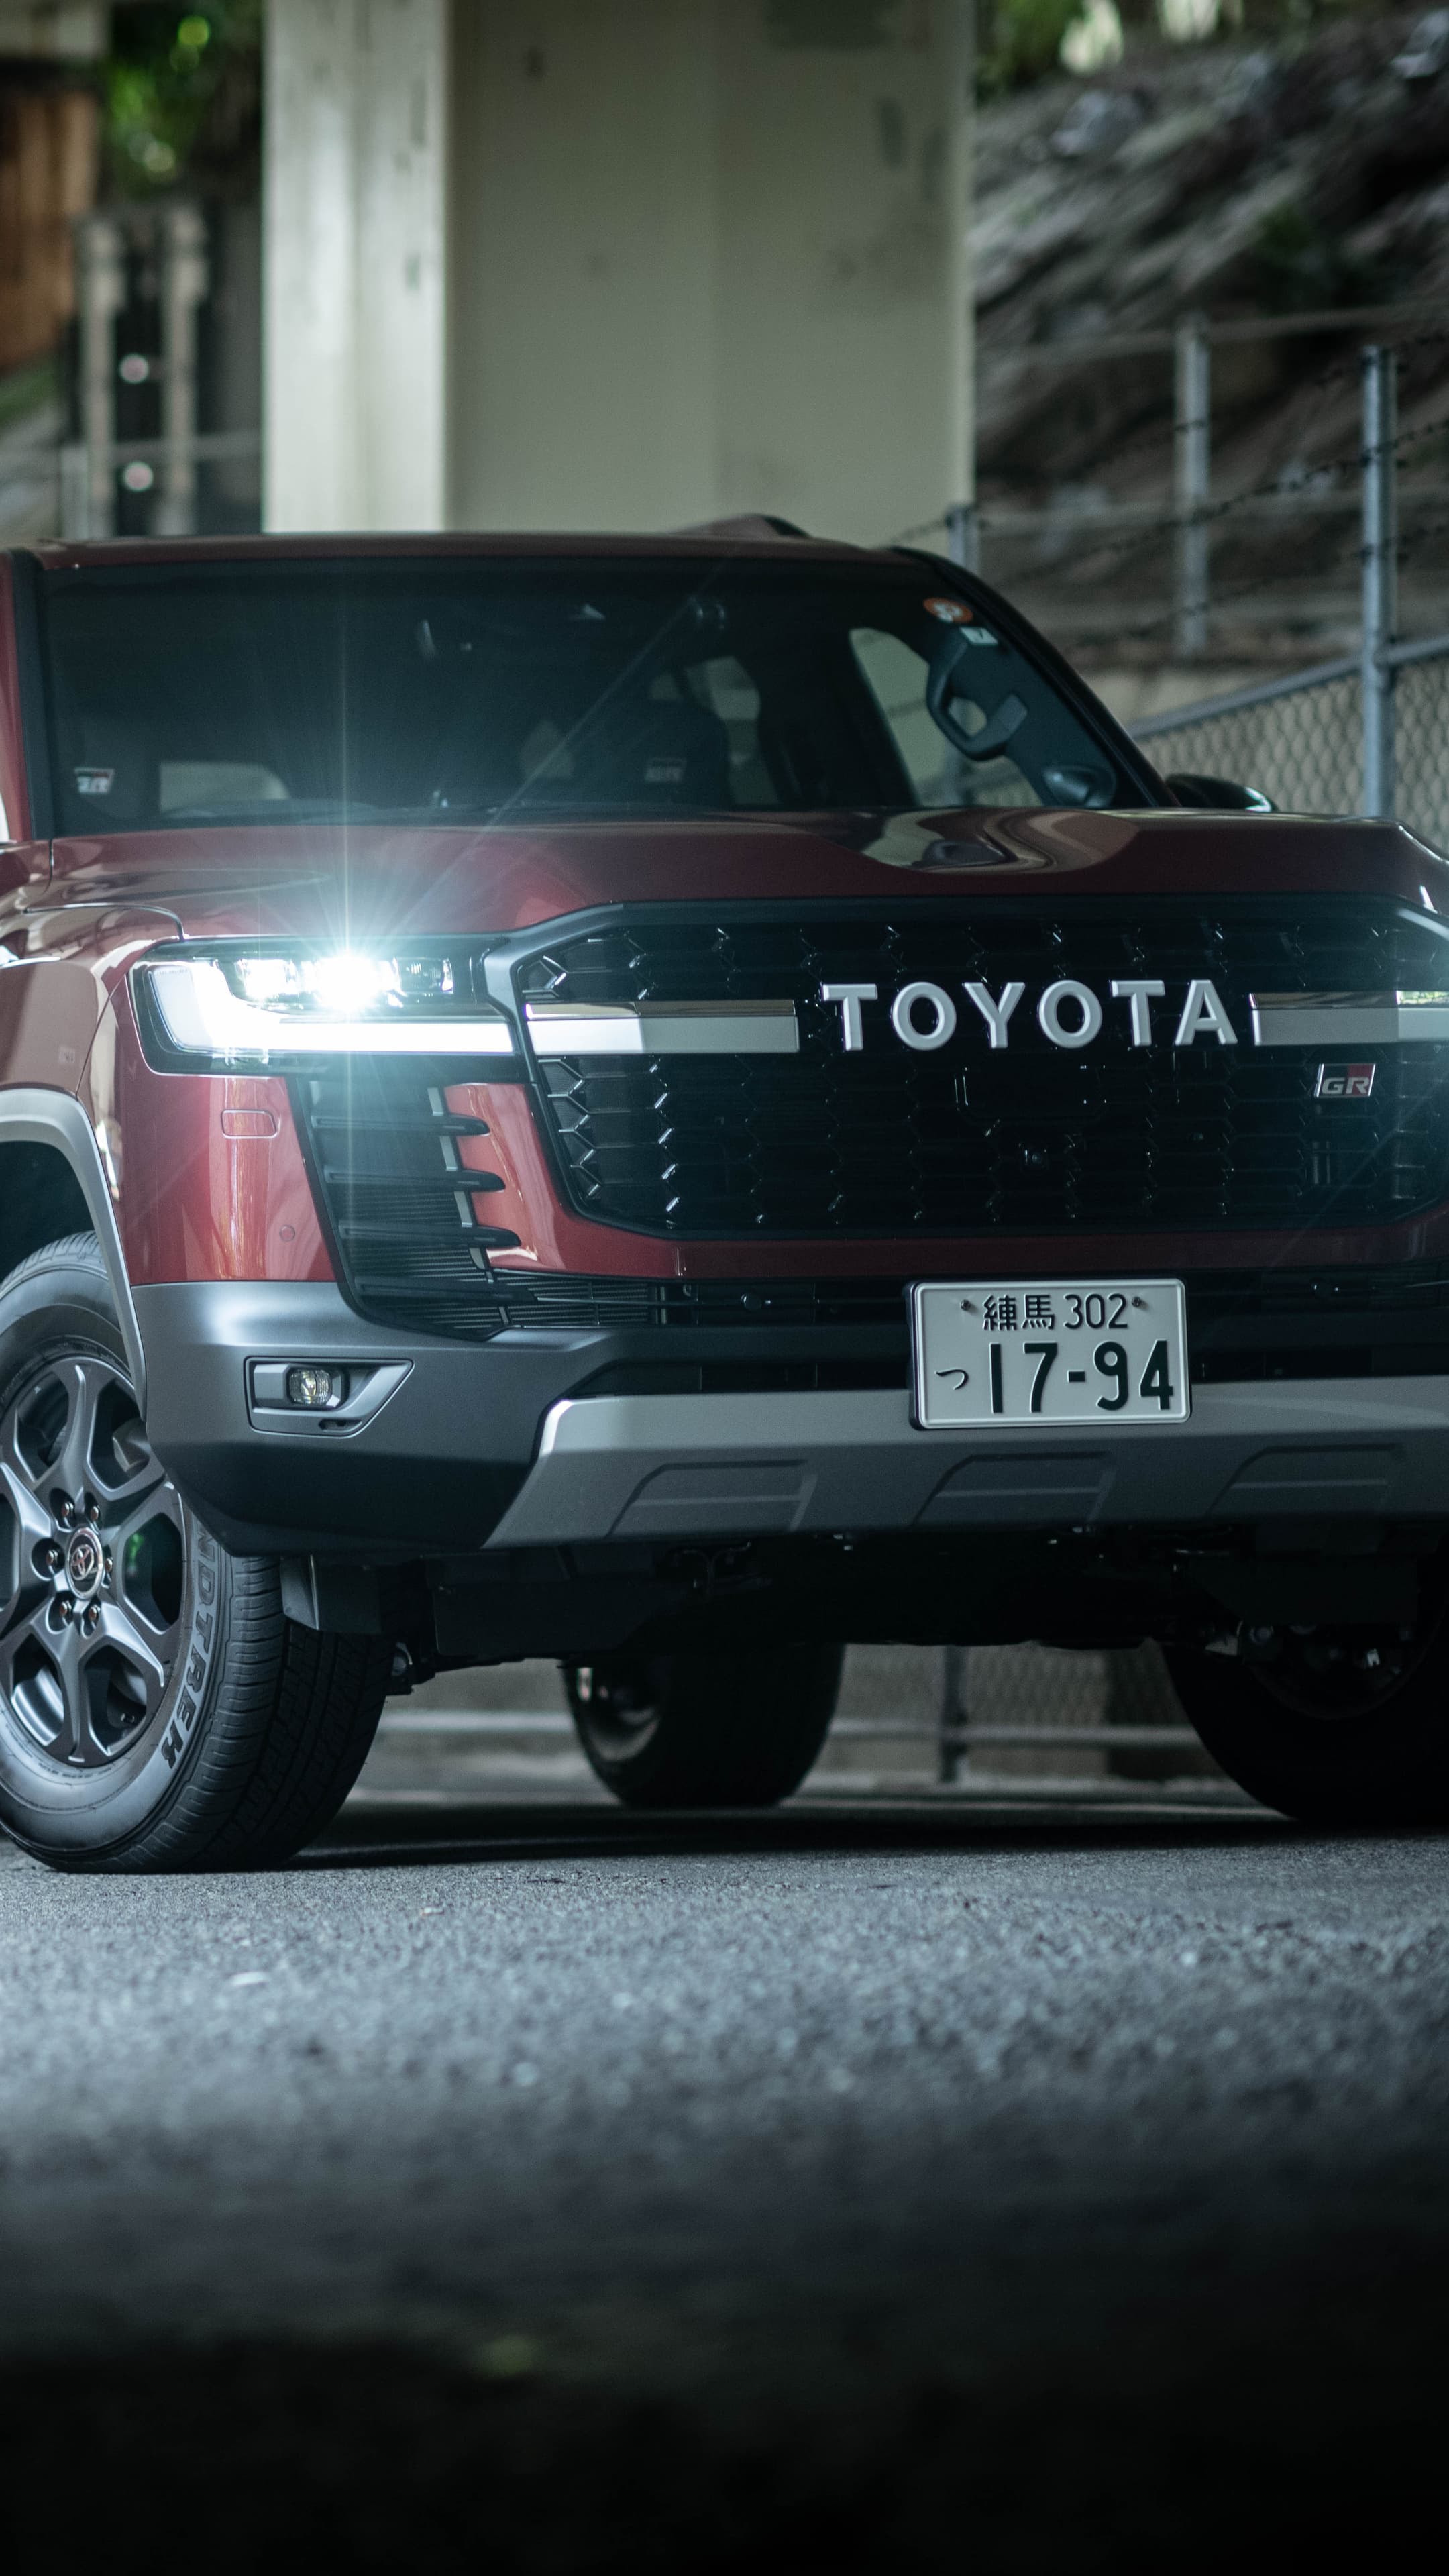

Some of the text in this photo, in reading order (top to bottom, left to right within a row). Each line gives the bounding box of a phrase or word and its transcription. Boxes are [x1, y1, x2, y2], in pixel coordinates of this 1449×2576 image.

[821, 979, 1238, 1051] TOYOTA
[1321, 1077, 1370, 1094] GR
[982, 1293, 1129, 1331] 練馬 302
[935, 1339, 1174, 1414] つ 17-94
